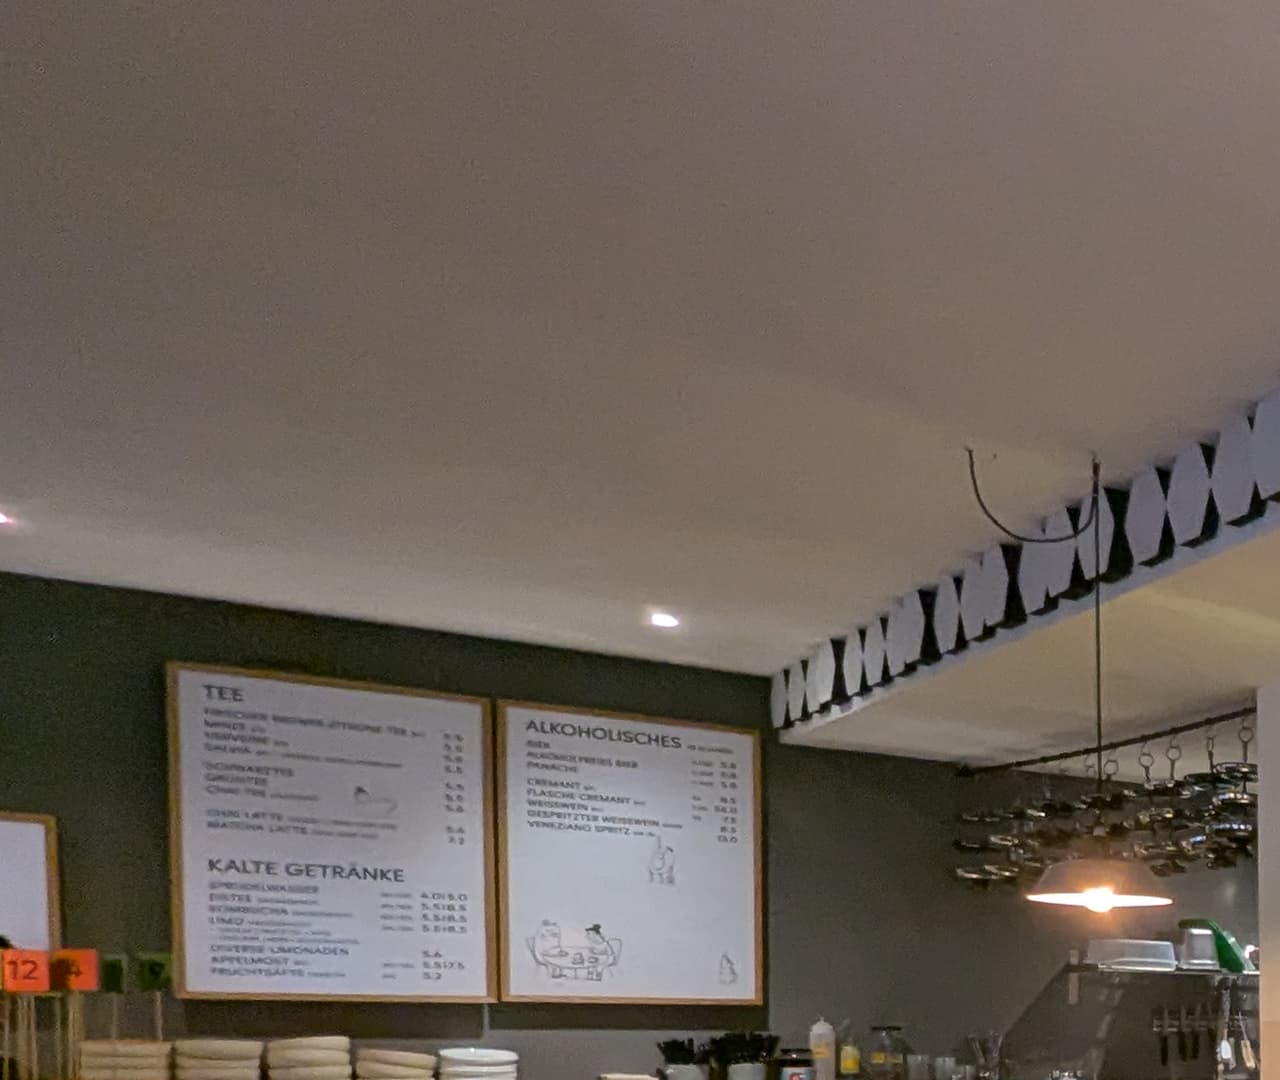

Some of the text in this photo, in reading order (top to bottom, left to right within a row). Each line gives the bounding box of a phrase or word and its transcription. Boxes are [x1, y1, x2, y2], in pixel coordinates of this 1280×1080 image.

[203, 684, 244, 702] TEE
[526, 719, 683, 749] ALKOHOLISCHES
[207, 858, 406, 883] KALTE GETRÄNKE
[7, 958, 39, 981] 12
